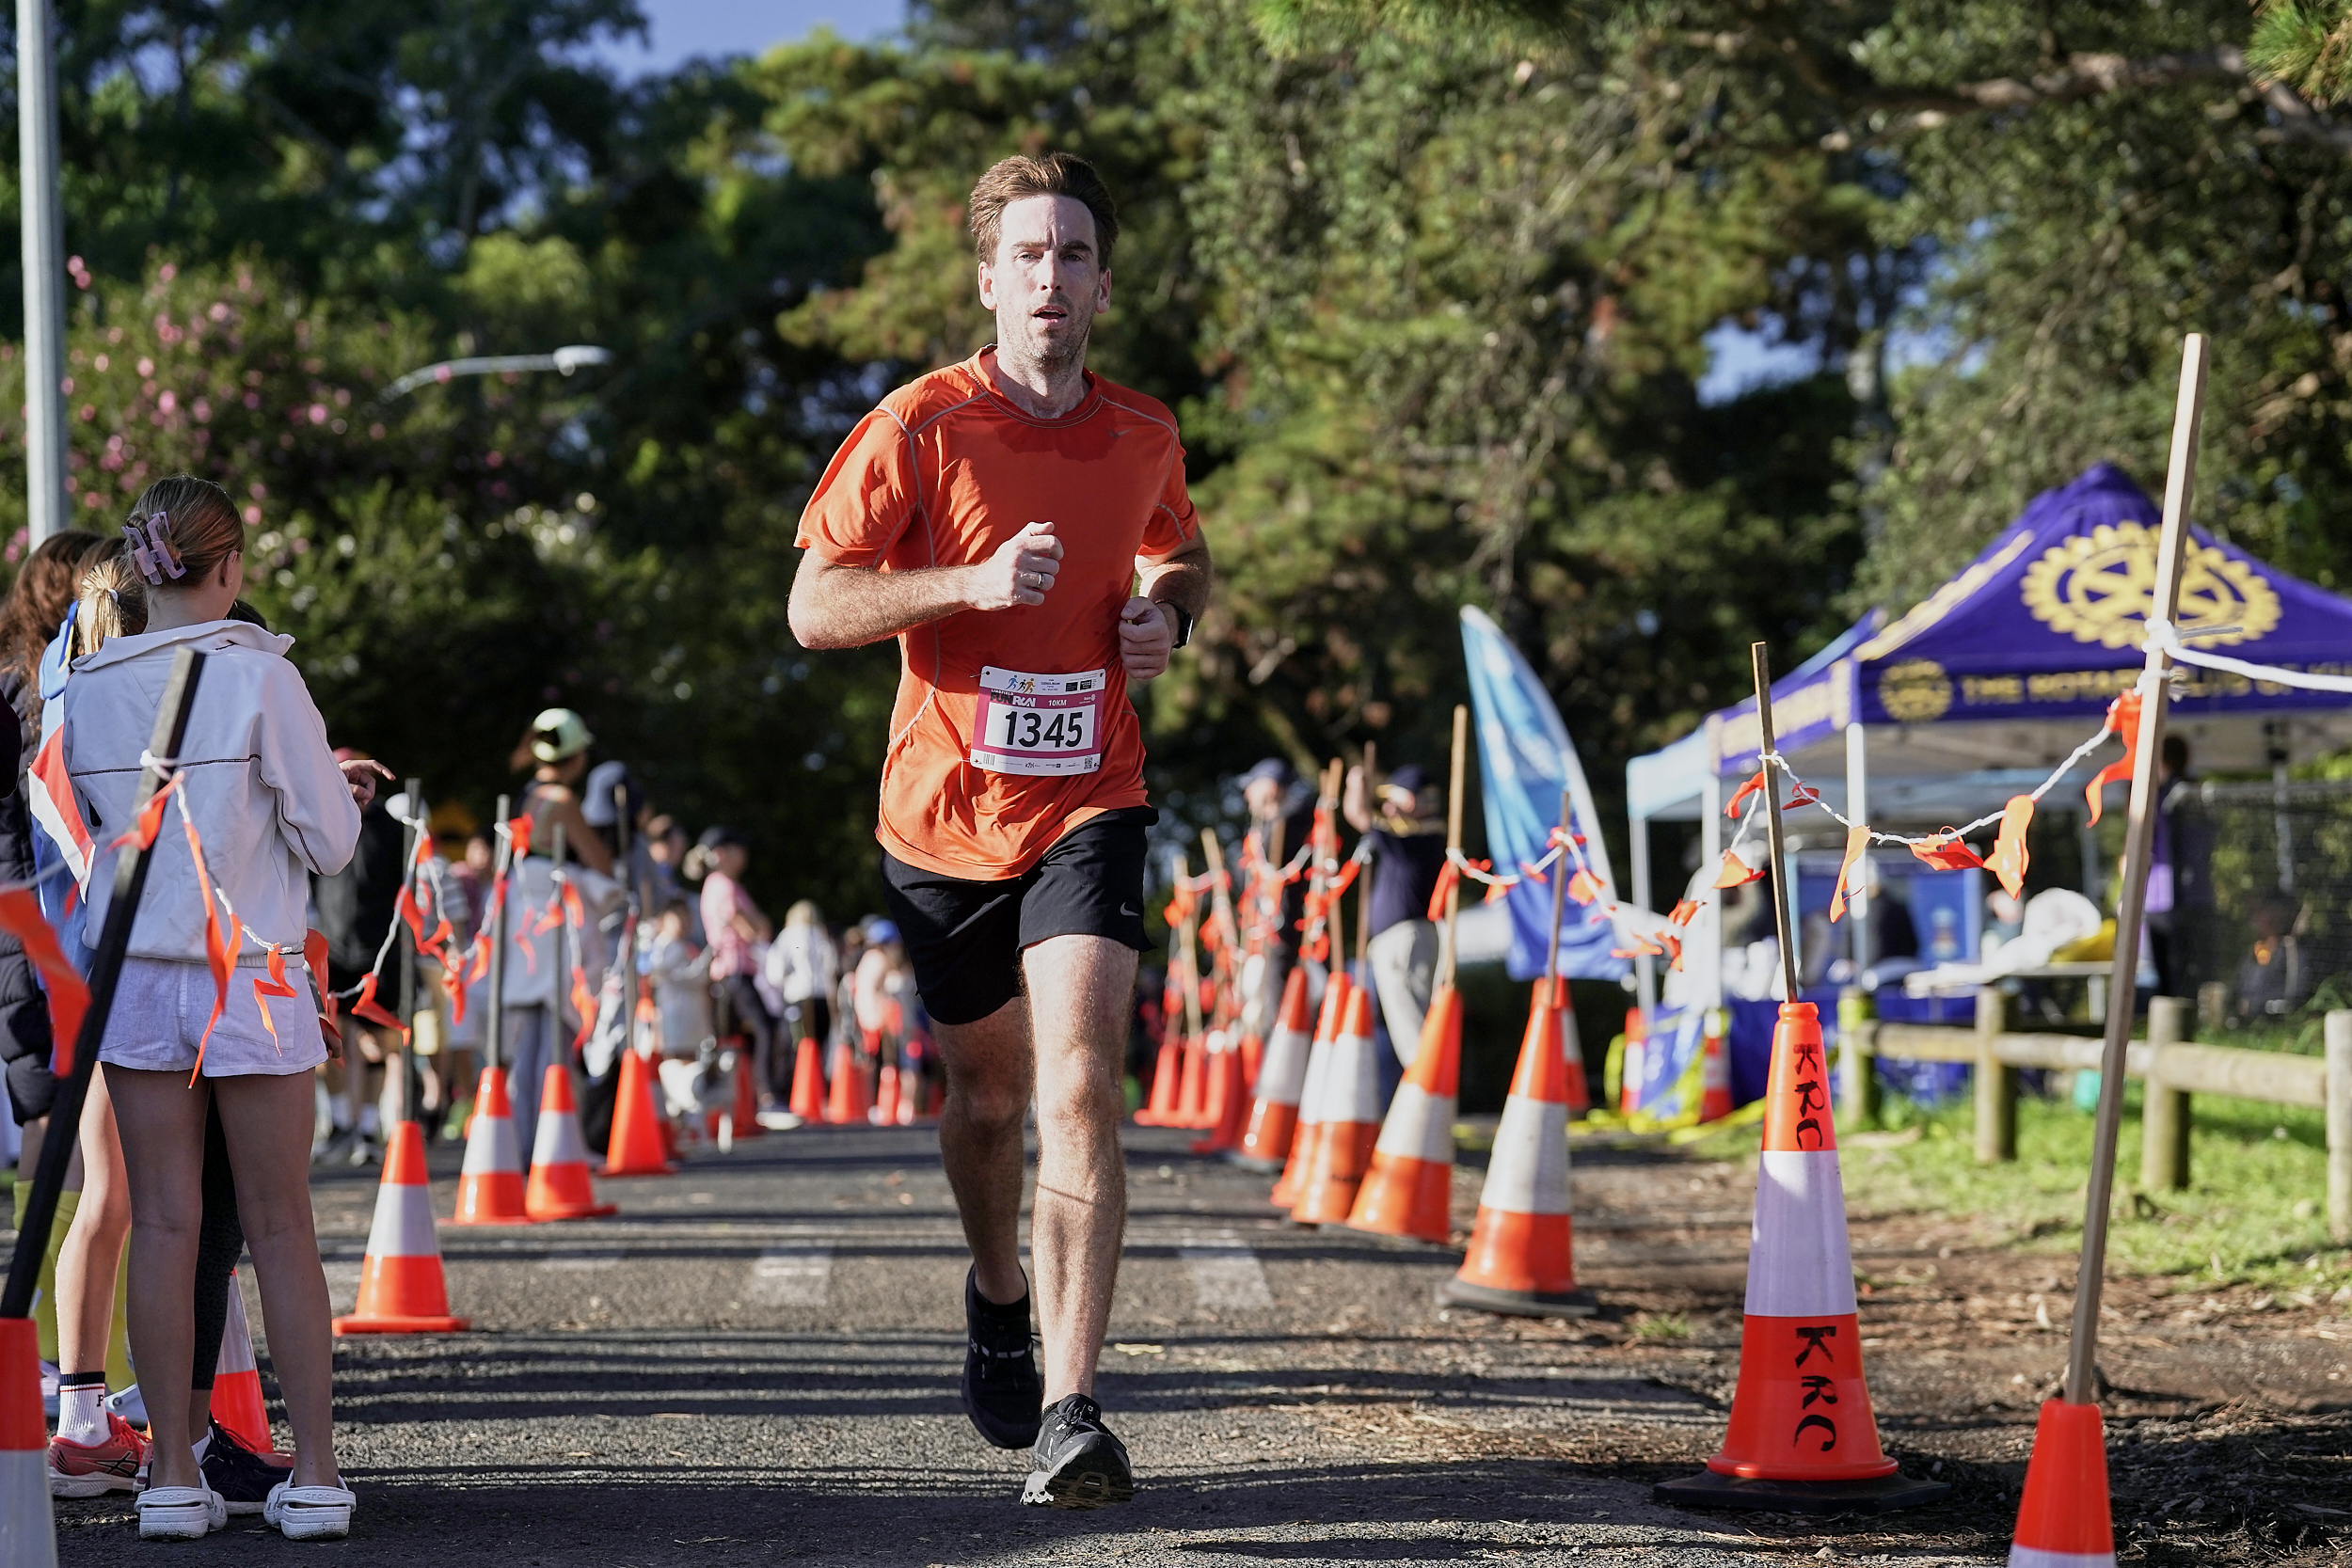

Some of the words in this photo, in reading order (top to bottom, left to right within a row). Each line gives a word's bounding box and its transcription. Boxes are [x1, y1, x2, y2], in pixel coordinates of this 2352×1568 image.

[1962, 676, 2023, 704] THE
[2027, 670, 2142, 703] ROTAR
[1005, 710, 1084, 748] 1345
[1793, 1043, 1825, 1149] KRC
[1793, 1325, 1837, 1452] KRC
[156, 1491, 188, 1501] crocs
[304, 1491, 337, 1500] crocs
